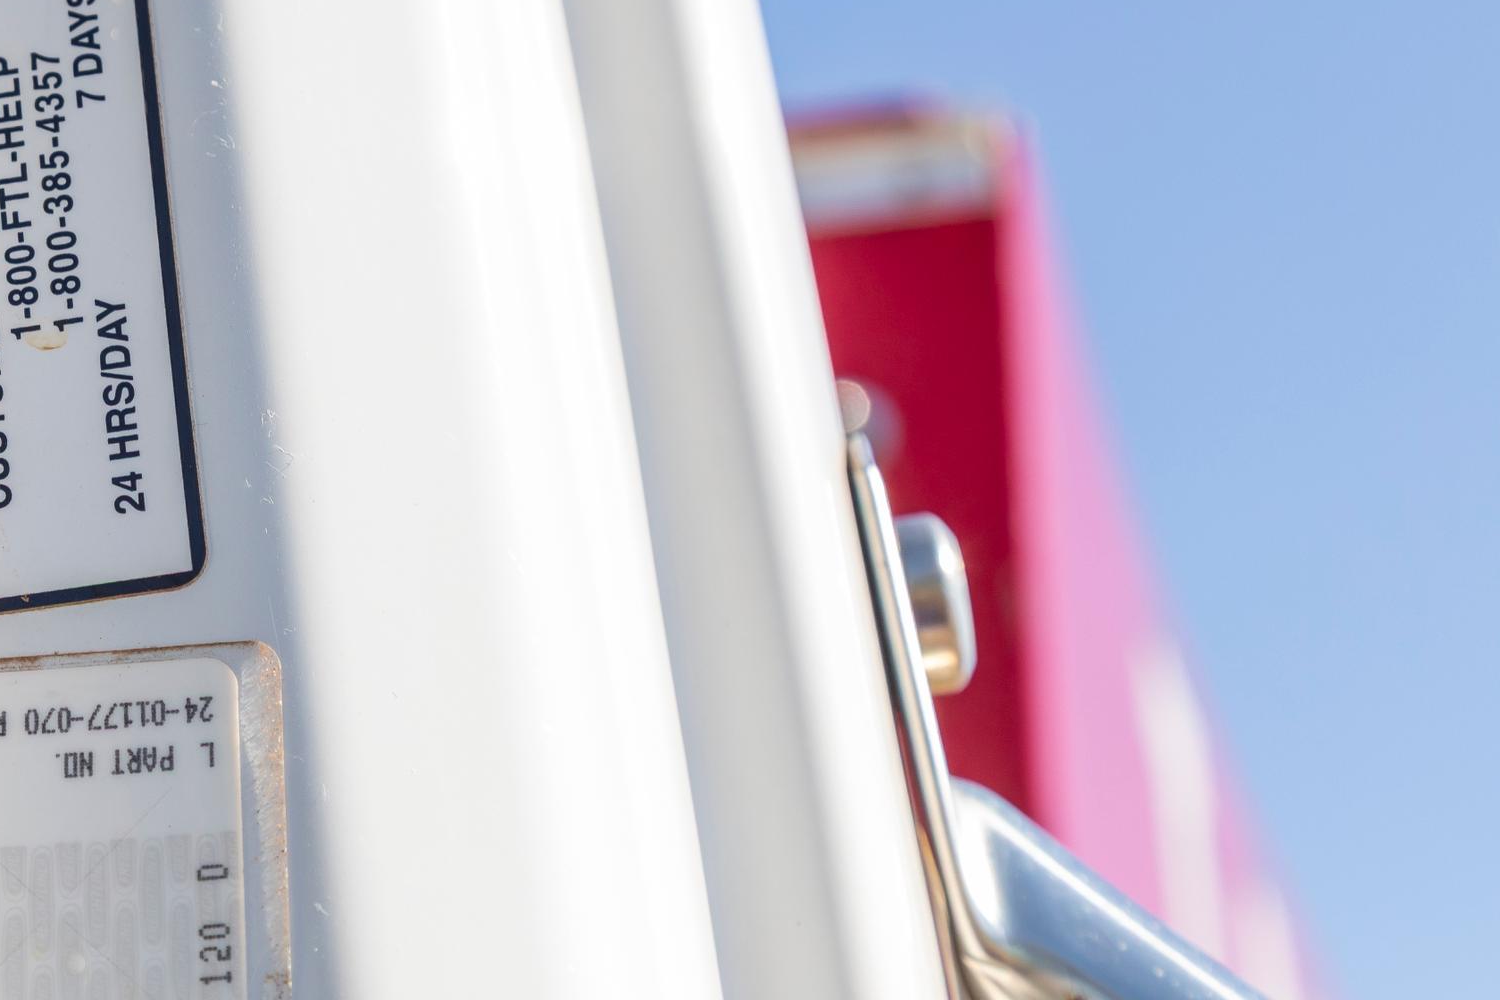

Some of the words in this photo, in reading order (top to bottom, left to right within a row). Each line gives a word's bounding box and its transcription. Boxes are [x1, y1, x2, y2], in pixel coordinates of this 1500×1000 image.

[75, 89, 106, 109] 7
[30, 52, 84, 333] 1-800-385-4357
[94, 298, 142, 462] HRS/DAY
[111, 471, 146, 515] 24
[24, 695, 215, 737] 24-01177-070
[55, 751, 95, 780] NO.
[111, 745, 176, 777] PART
[199, 741, 216, 769] L
[198, 922, 234, 986] 120
